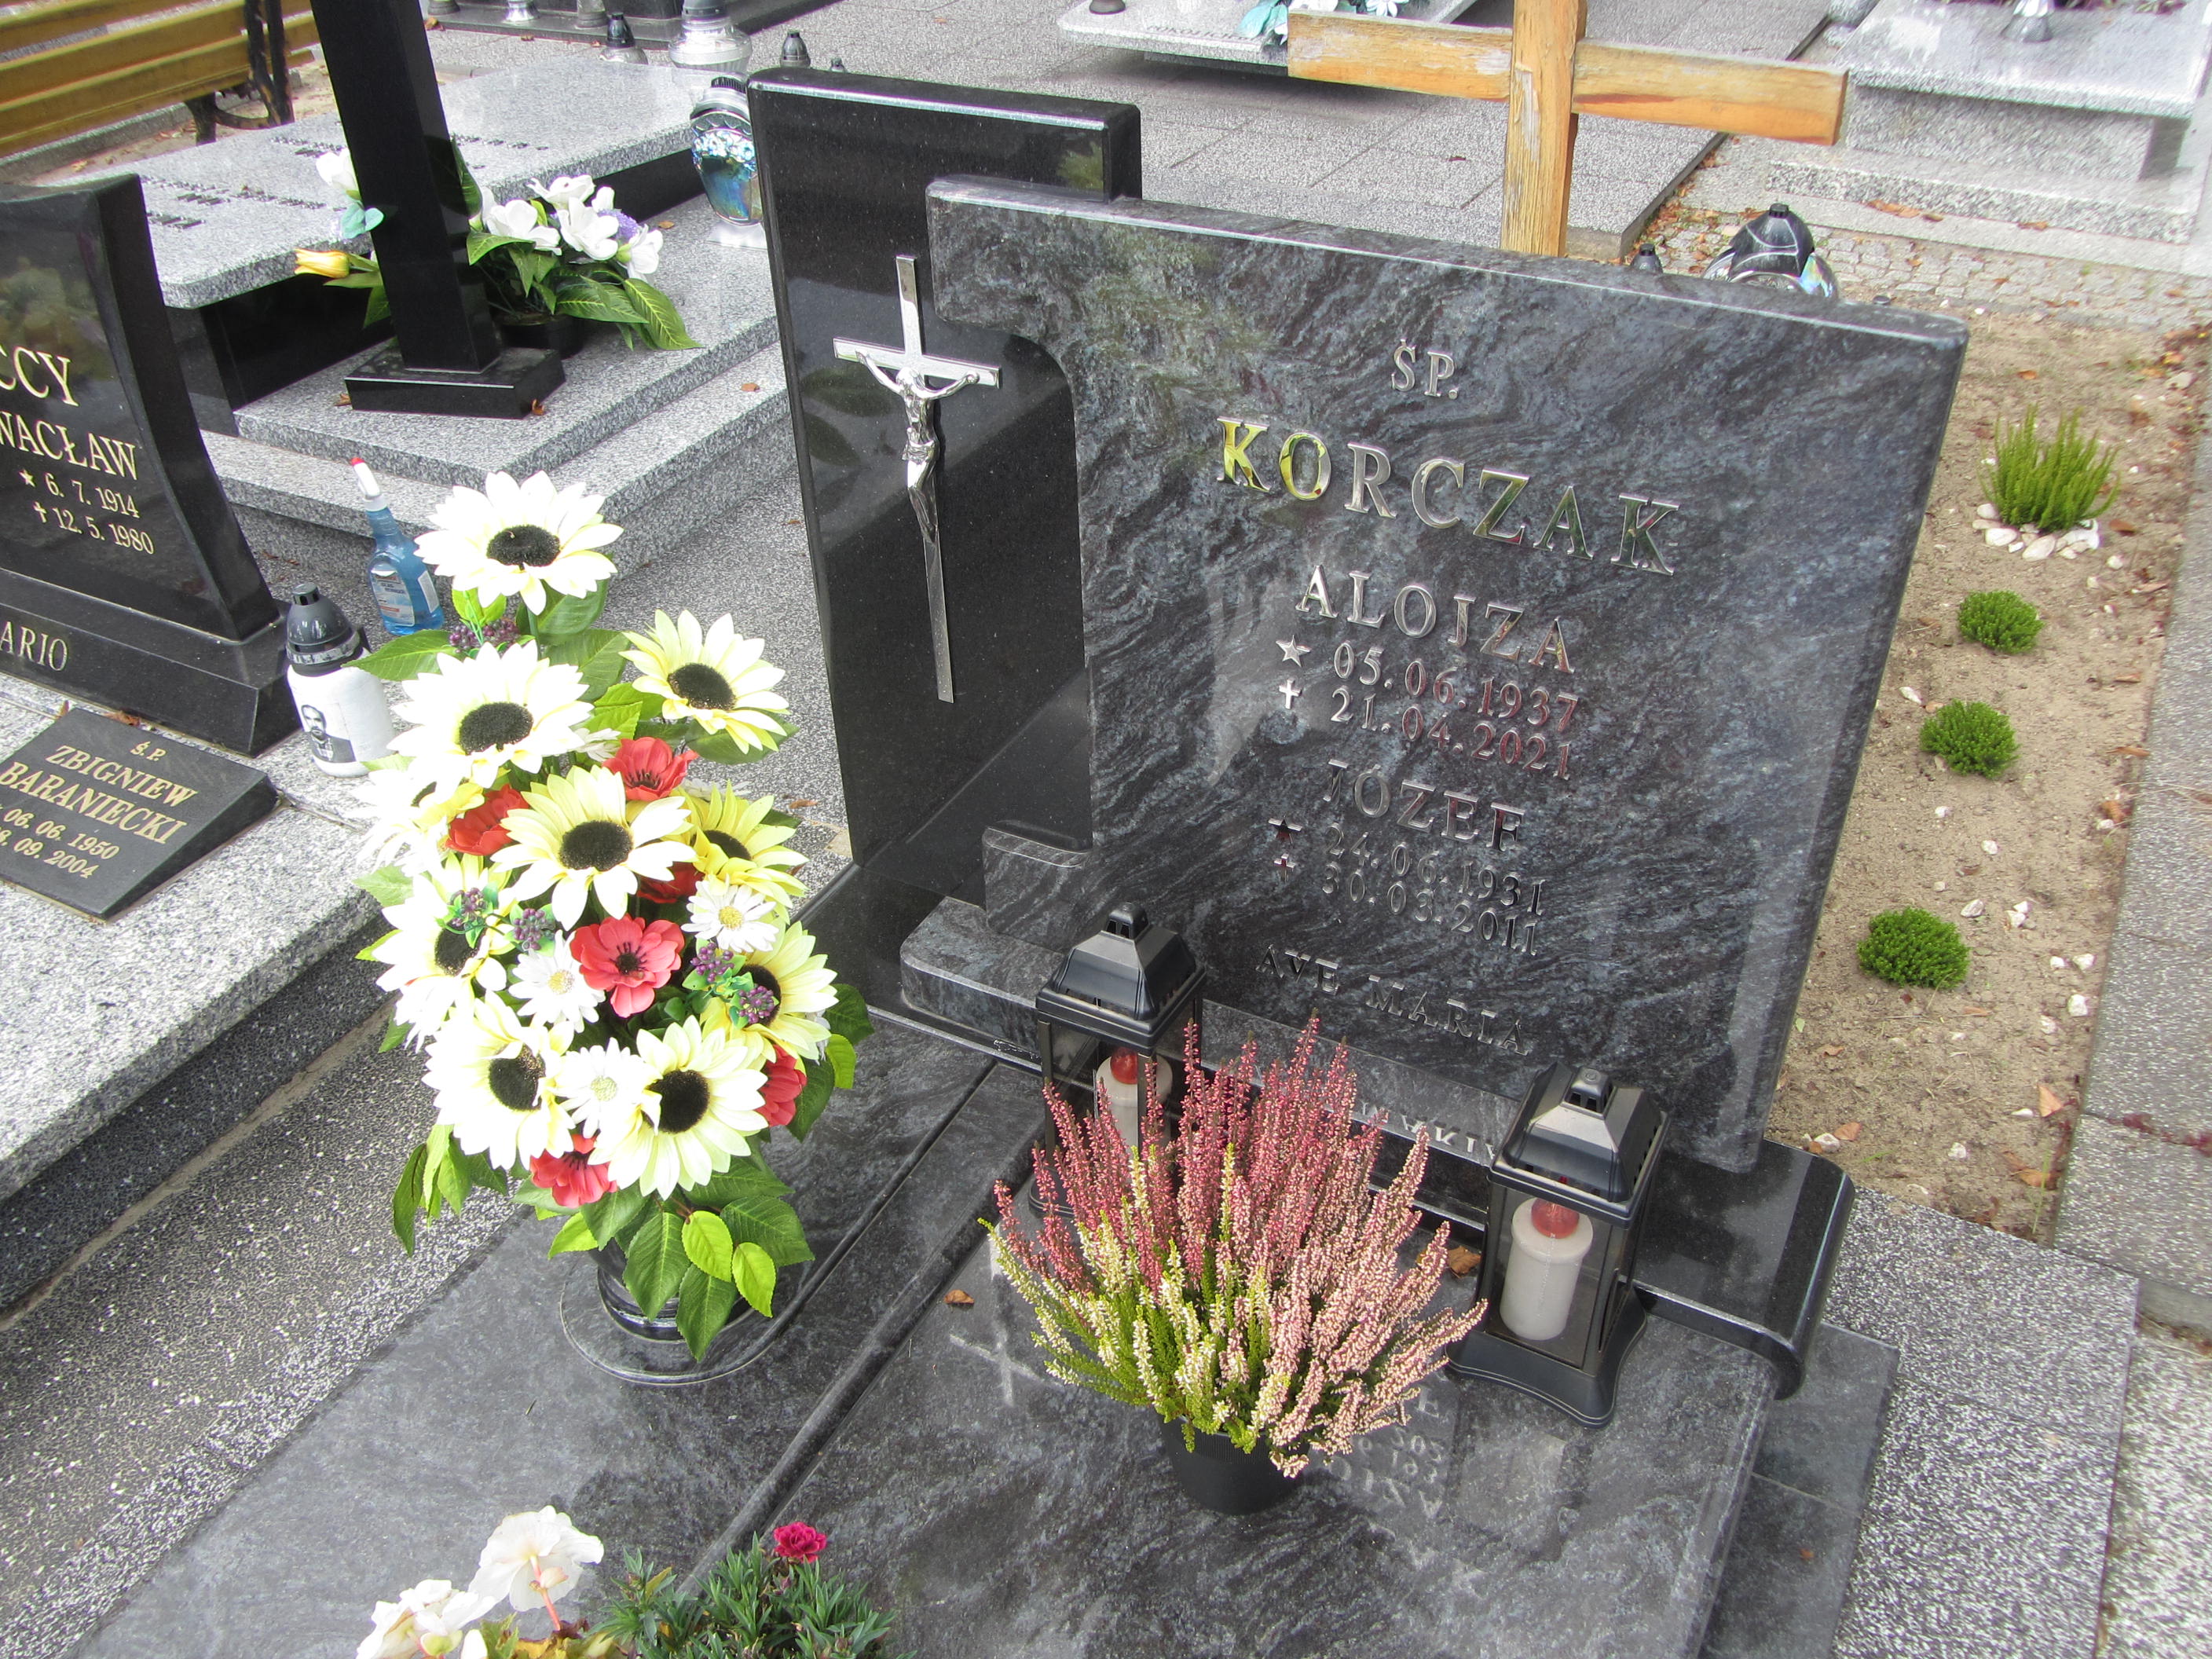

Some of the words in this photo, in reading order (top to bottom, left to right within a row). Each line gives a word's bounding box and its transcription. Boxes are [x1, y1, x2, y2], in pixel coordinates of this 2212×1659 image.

[94, 486, 141, 518] 1914
[1216, 417, 1680, 577] KORCZAK
[108, 523, 155, 555] 1980
[1295, 565, 1576, 674] ALOJZA
[0, 761, 188, 844] BARANIECKI
[45, 745, 199, 807] ZBIGNIEW
[1322, 758, 1525, 851] JÓZEF
[44, 850, 100, 879] 2004
[68, 833, 120, 859] 1950
[1257, 944, 1340, 994] AVE
[1365, 975, 1529, 1056] MARIA
